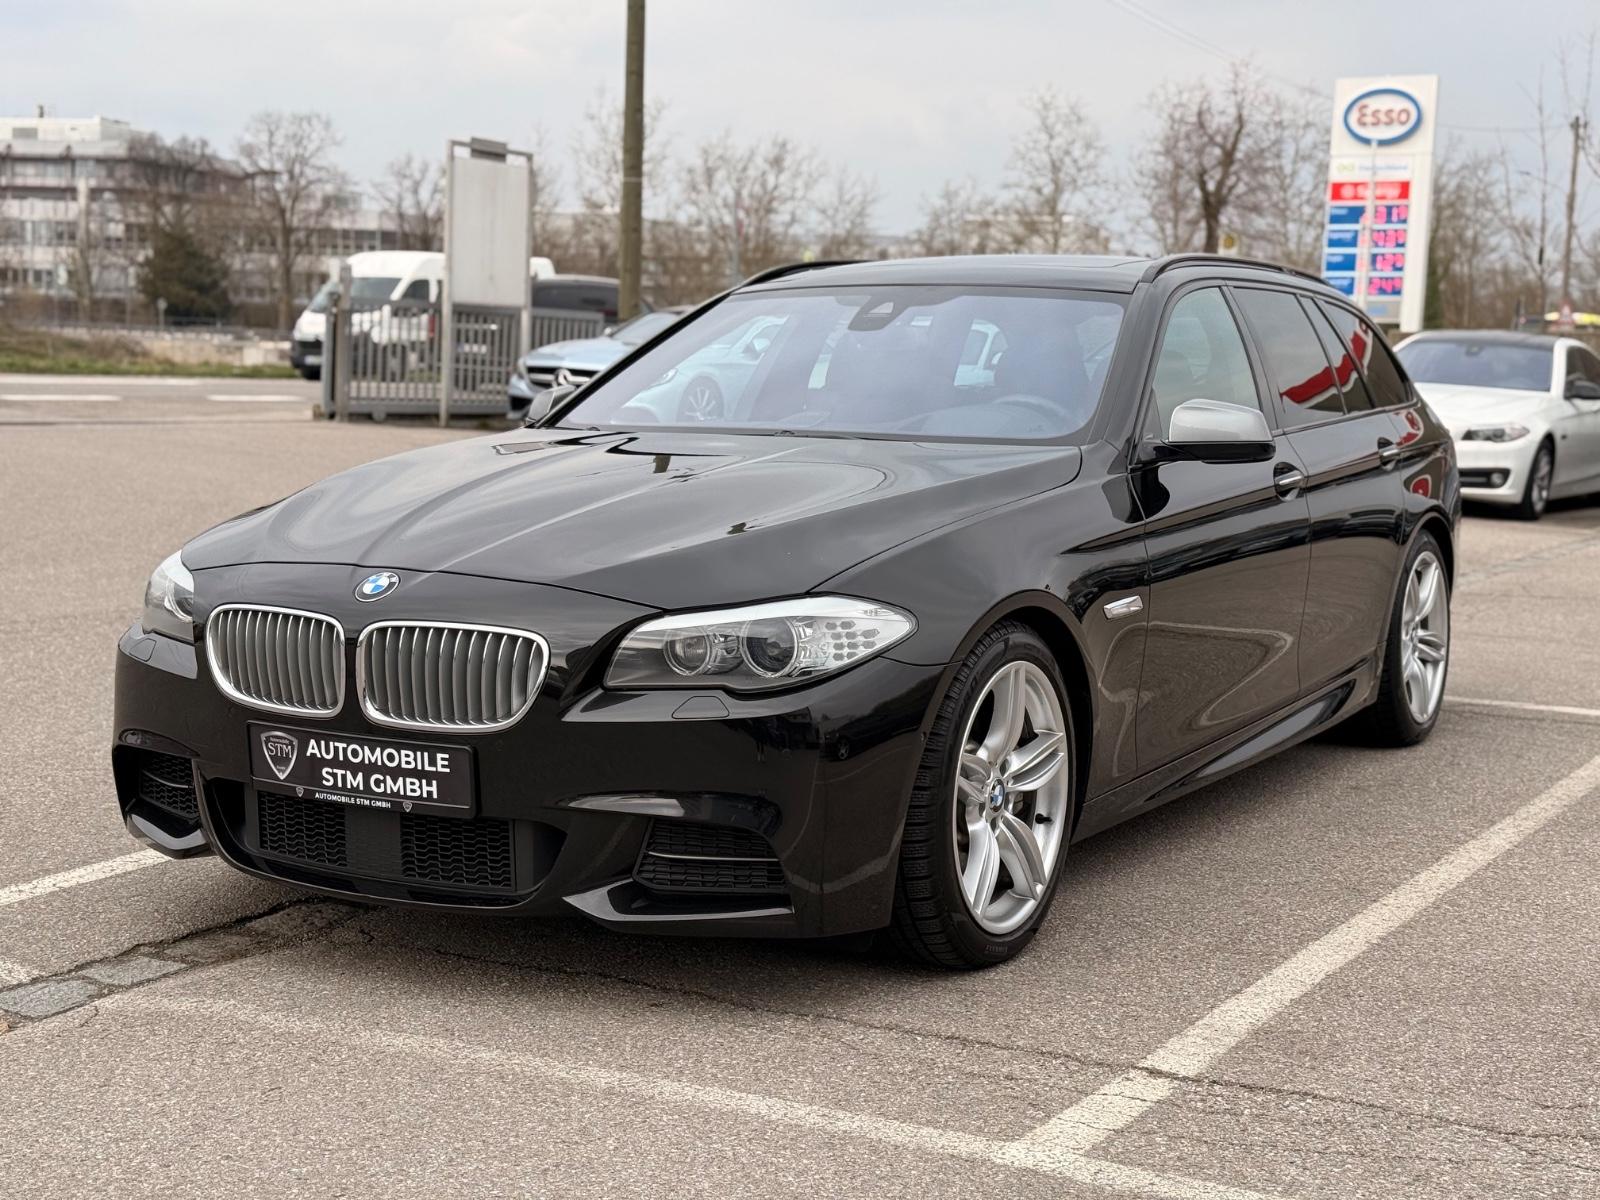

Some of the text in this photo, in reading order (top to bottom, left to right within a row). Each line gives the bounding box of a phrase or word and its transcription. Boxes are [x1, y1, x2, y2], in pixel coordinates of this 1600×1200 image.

[1356, 104, 1410, 127] Esso
[268, 742, 292, 758] STM
[306, 739, 451, 773] AUTOMOBILE
[321, 767, 438, 799] STM GMBH
[315, 792, 391, 809] AUTOMOBILE STM GMBH
